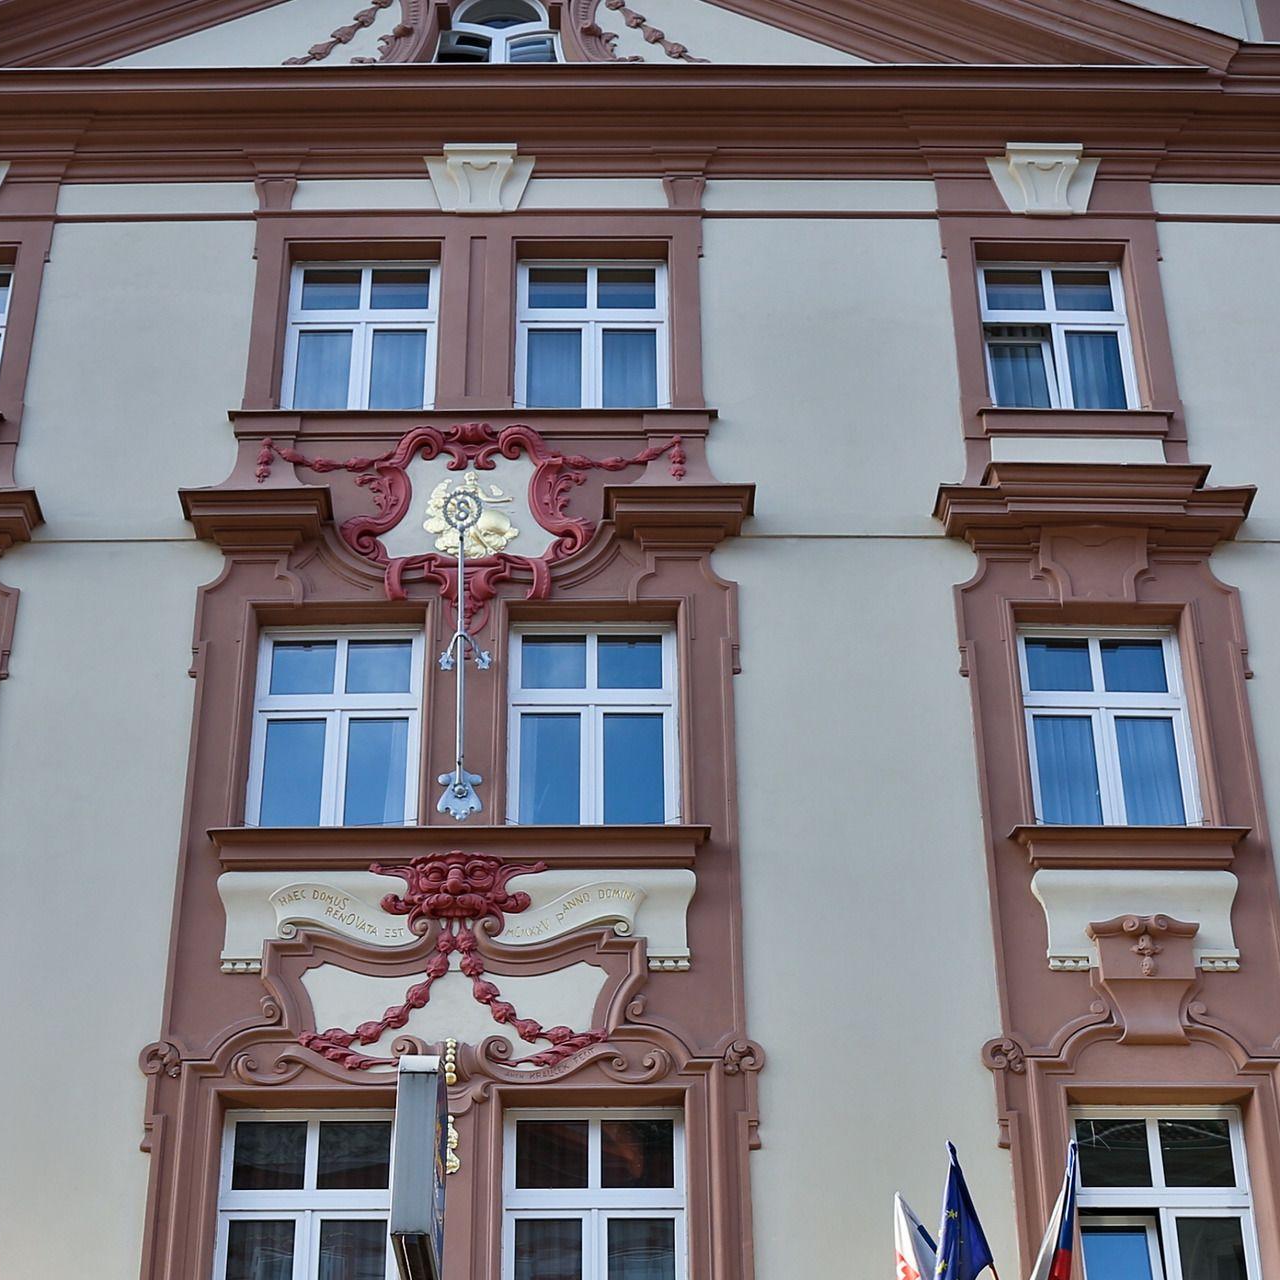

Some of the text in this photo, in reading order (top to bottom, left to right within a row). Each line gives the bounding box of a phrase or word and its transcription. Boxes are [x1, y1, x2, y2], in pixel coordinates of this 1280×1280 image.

[278, 889, 350, 911] HAEC DOMUS
[598, 889, 636, 901] DOMINI
[384, 928, 404, 938] EST
